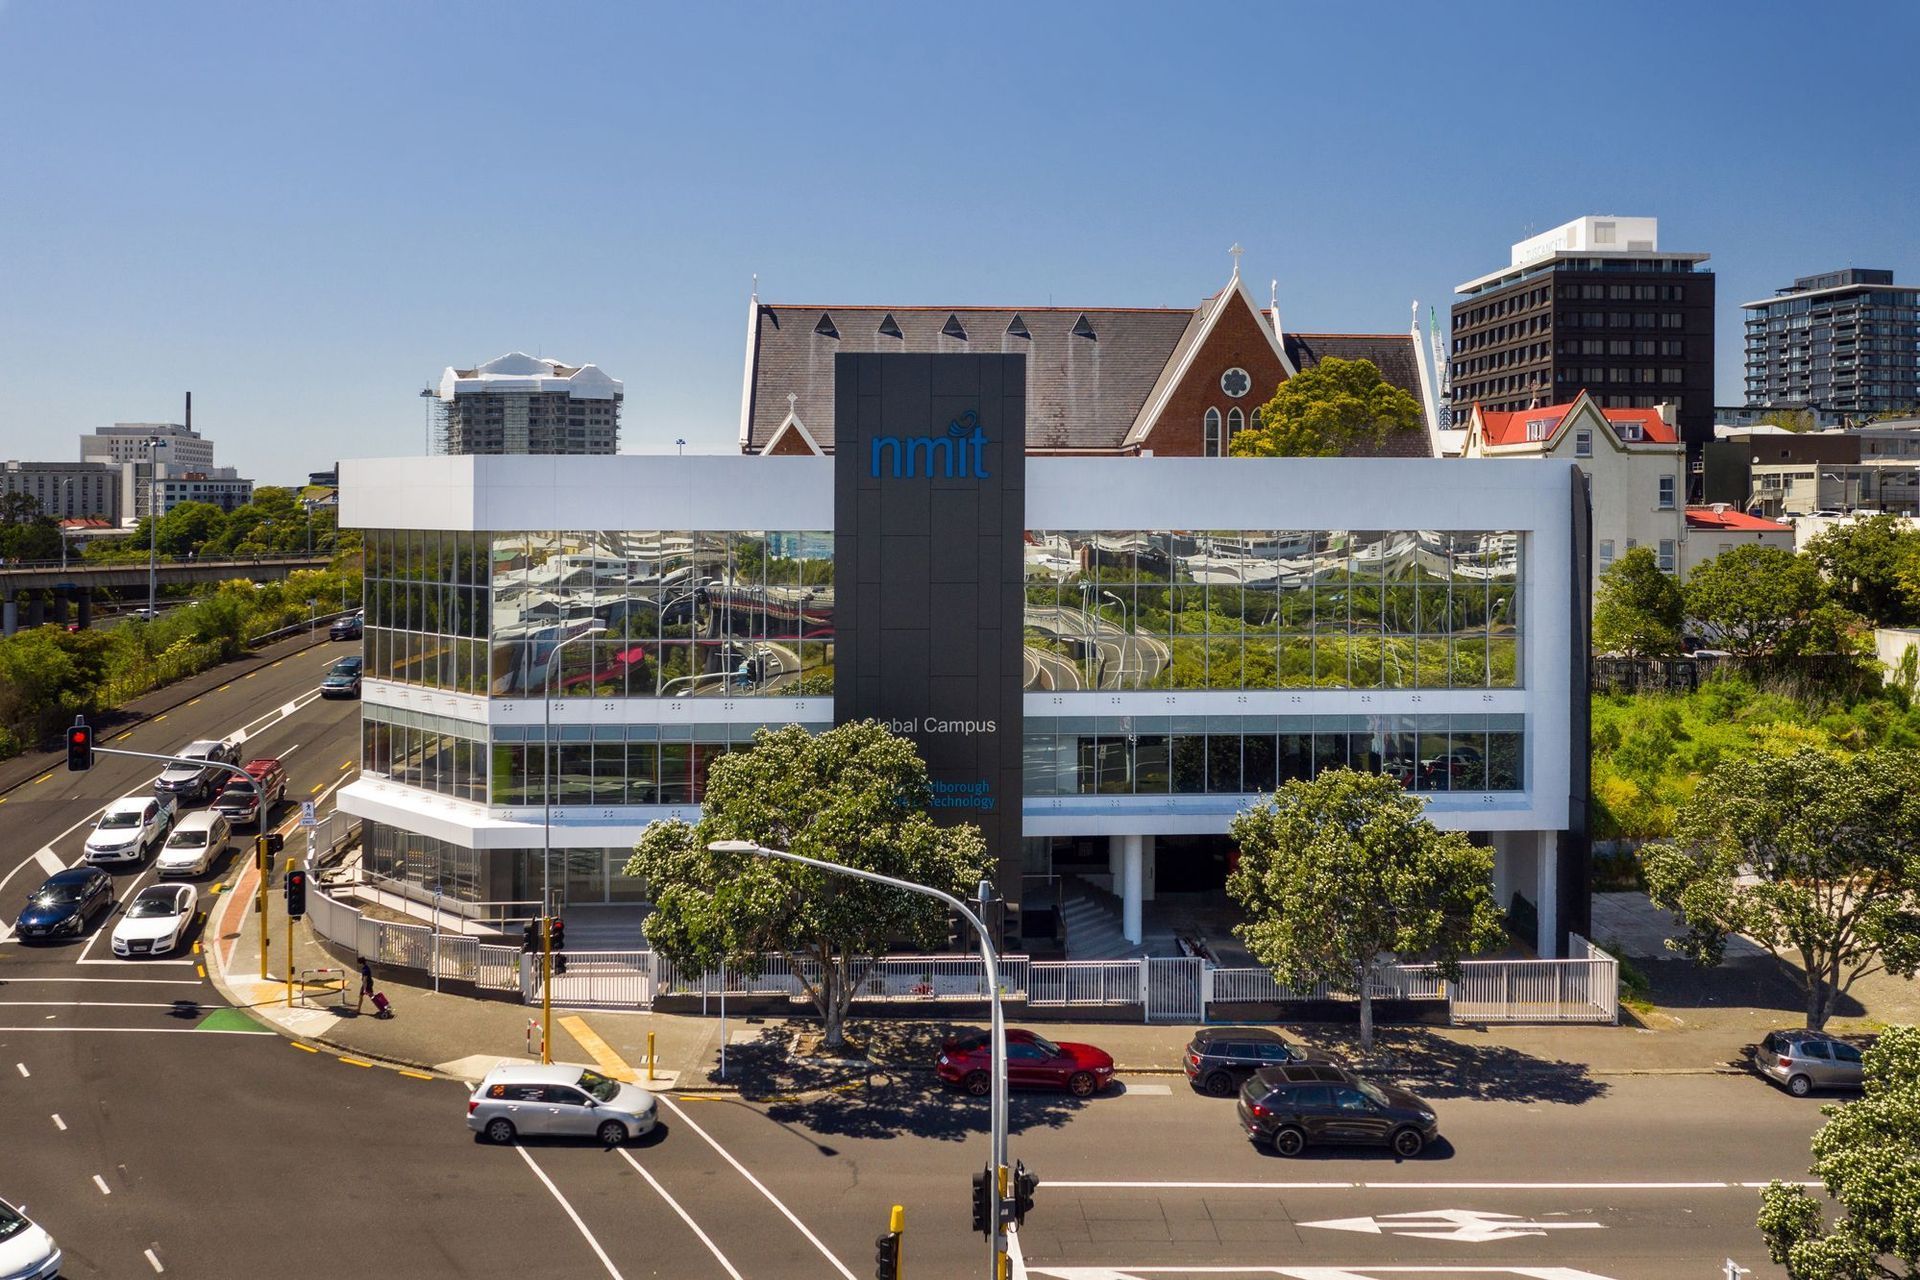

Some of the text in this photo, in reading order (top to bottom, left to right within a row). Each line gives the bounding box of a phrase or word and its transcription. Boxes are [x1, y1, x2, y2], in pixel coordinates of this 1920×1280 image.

[871, 424, 991, 480] nmit
[923, 717, 997, 736] Campus
[928, 779, 990, 795] rlborough
